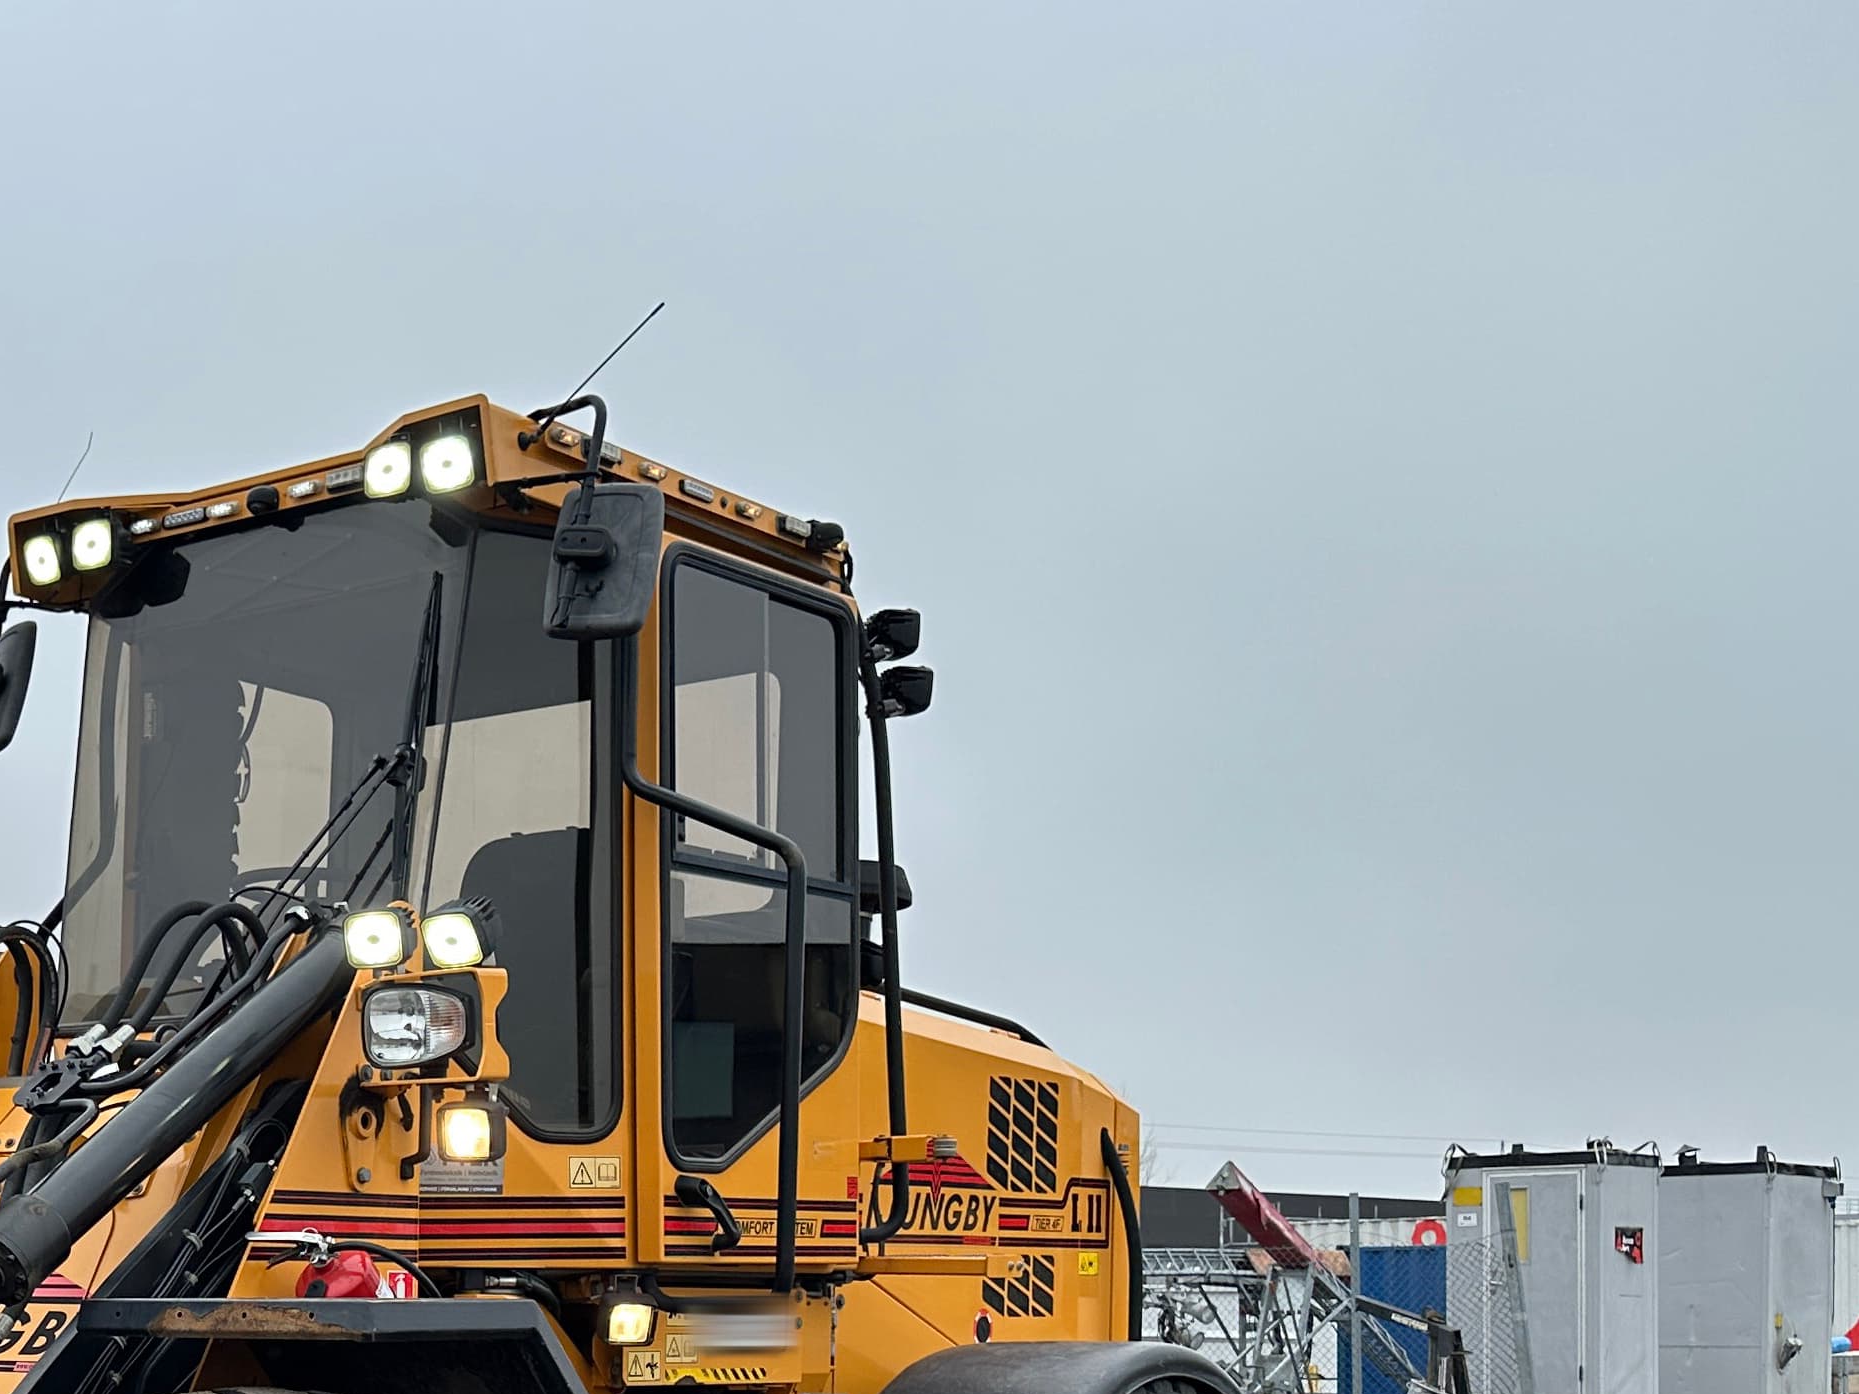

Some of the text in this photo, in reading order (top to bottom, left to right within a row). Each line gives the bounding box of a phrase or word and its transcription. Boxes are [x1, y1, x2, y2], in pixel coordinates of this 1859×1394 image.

[865, 1192, 997, 1233] UNGBY
[736, 1220, 814, 1236] OMFORT TEM
